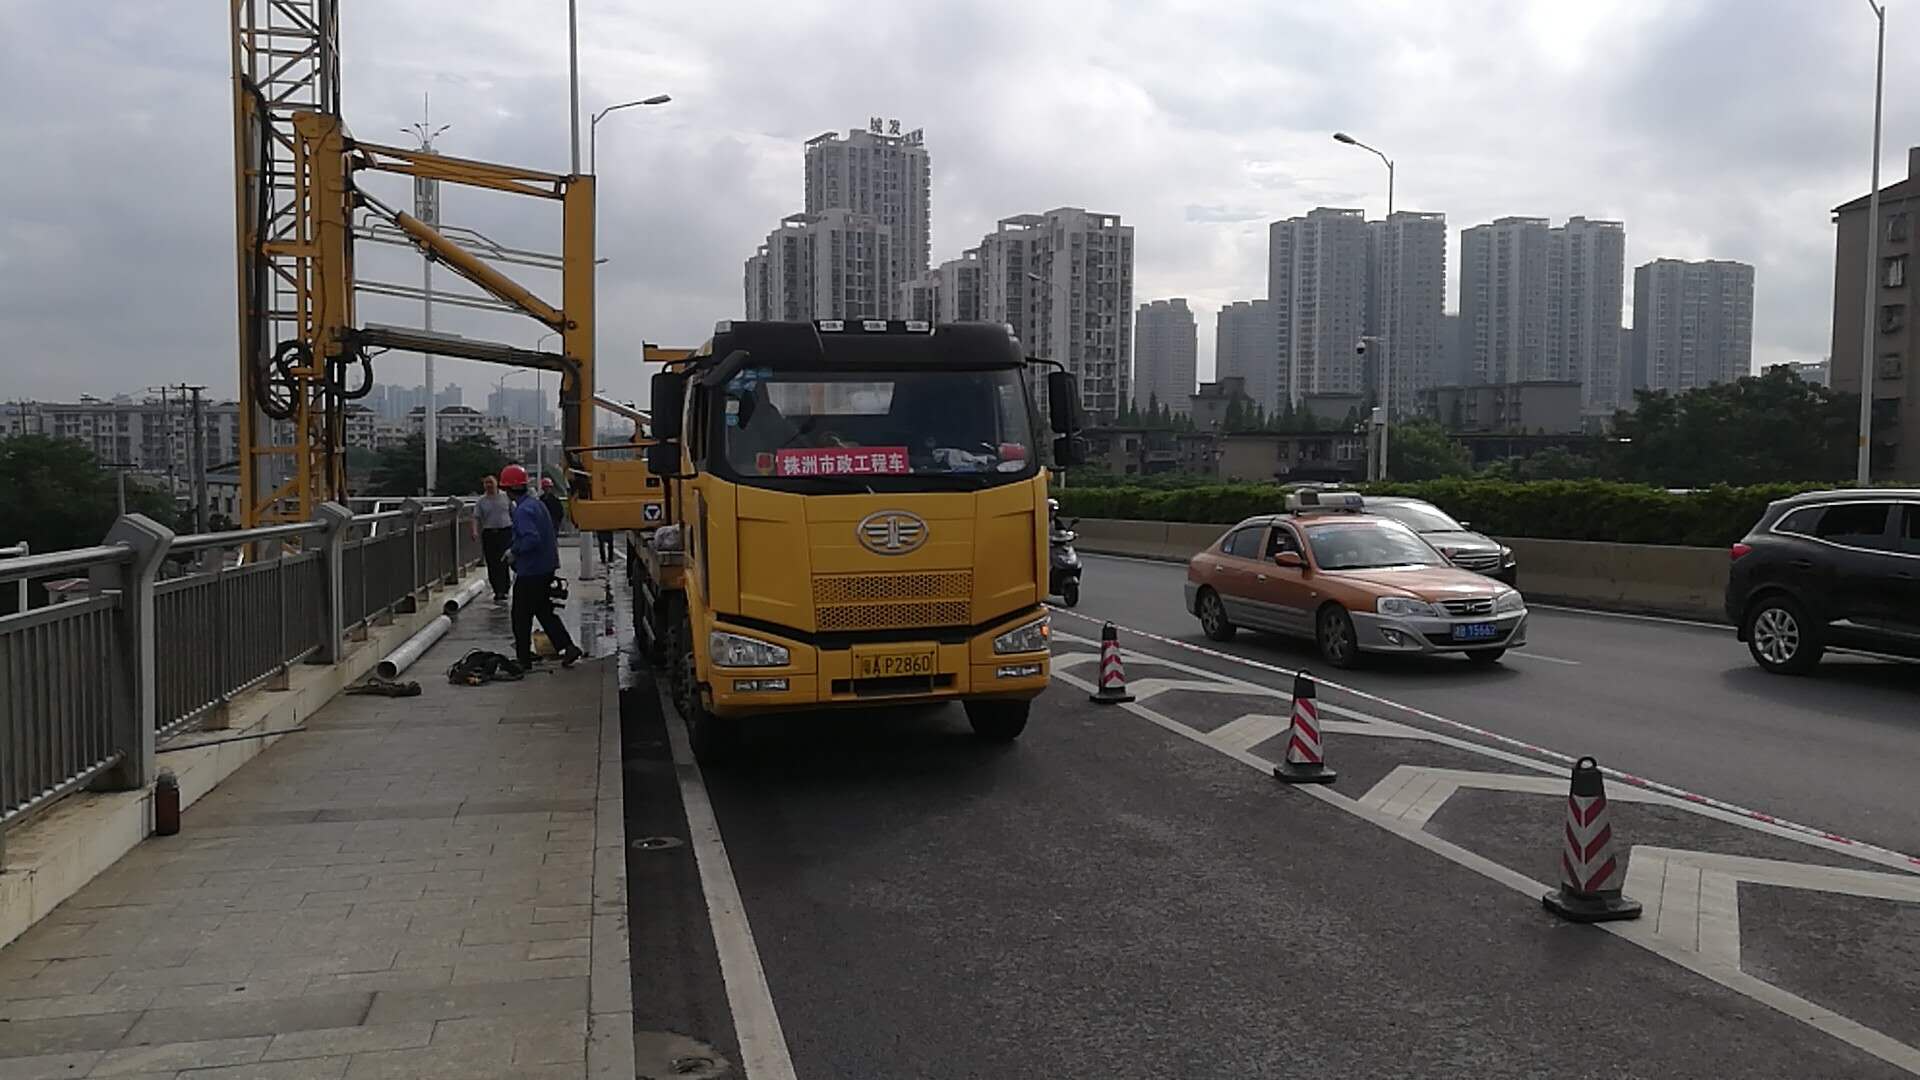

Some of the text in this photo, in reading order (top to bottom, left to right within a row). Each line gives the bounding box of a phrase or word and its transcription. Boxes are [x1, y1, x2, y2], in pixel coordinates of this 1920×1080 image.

[783, 452, 905, 475] 株洲市政工程车
